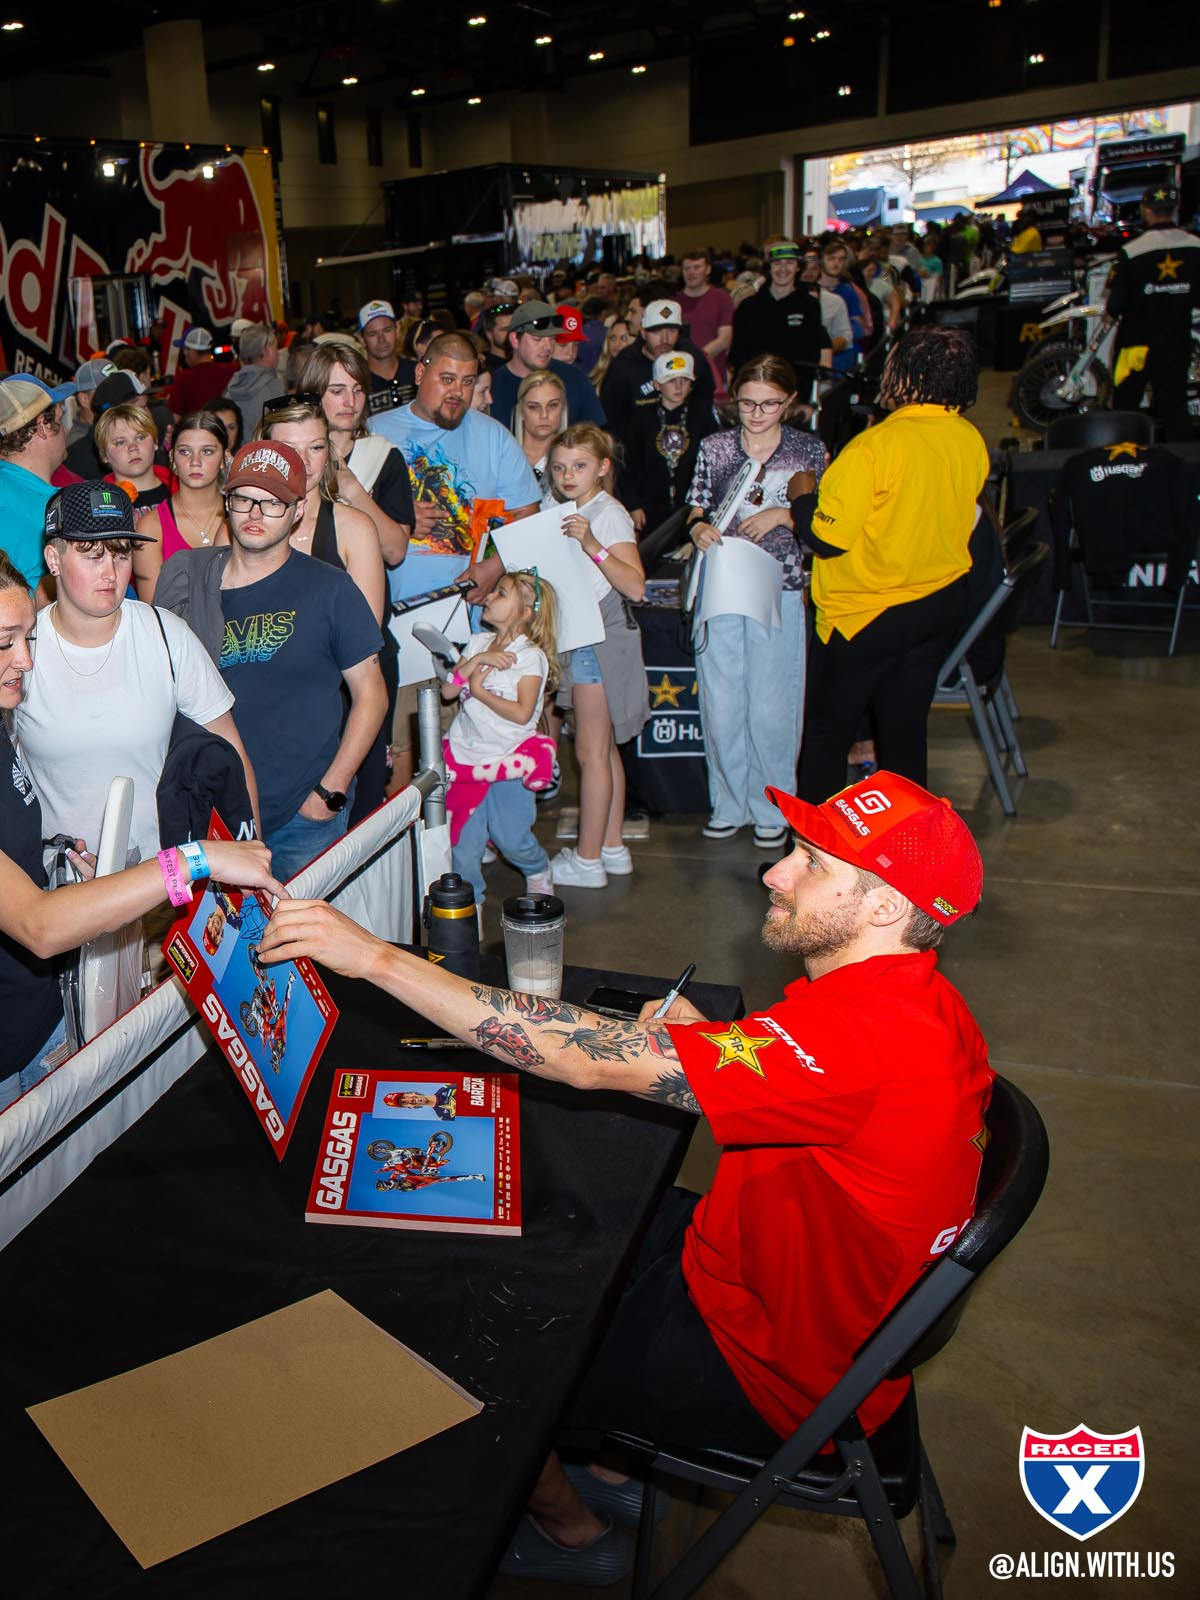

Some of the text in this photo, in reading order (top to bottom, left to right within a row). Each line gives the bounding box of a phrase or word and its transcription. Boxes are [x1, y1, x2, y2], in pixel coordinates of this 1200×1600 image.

[835, 798, 871, 837] GASGAS
[165, 859, 177, 878] FEST
[201, 992, 286, 1142] GASGAS
[470, 1077, 485, 1107] BARCIA
[315, 1110, 358, 1210] GASGAS
